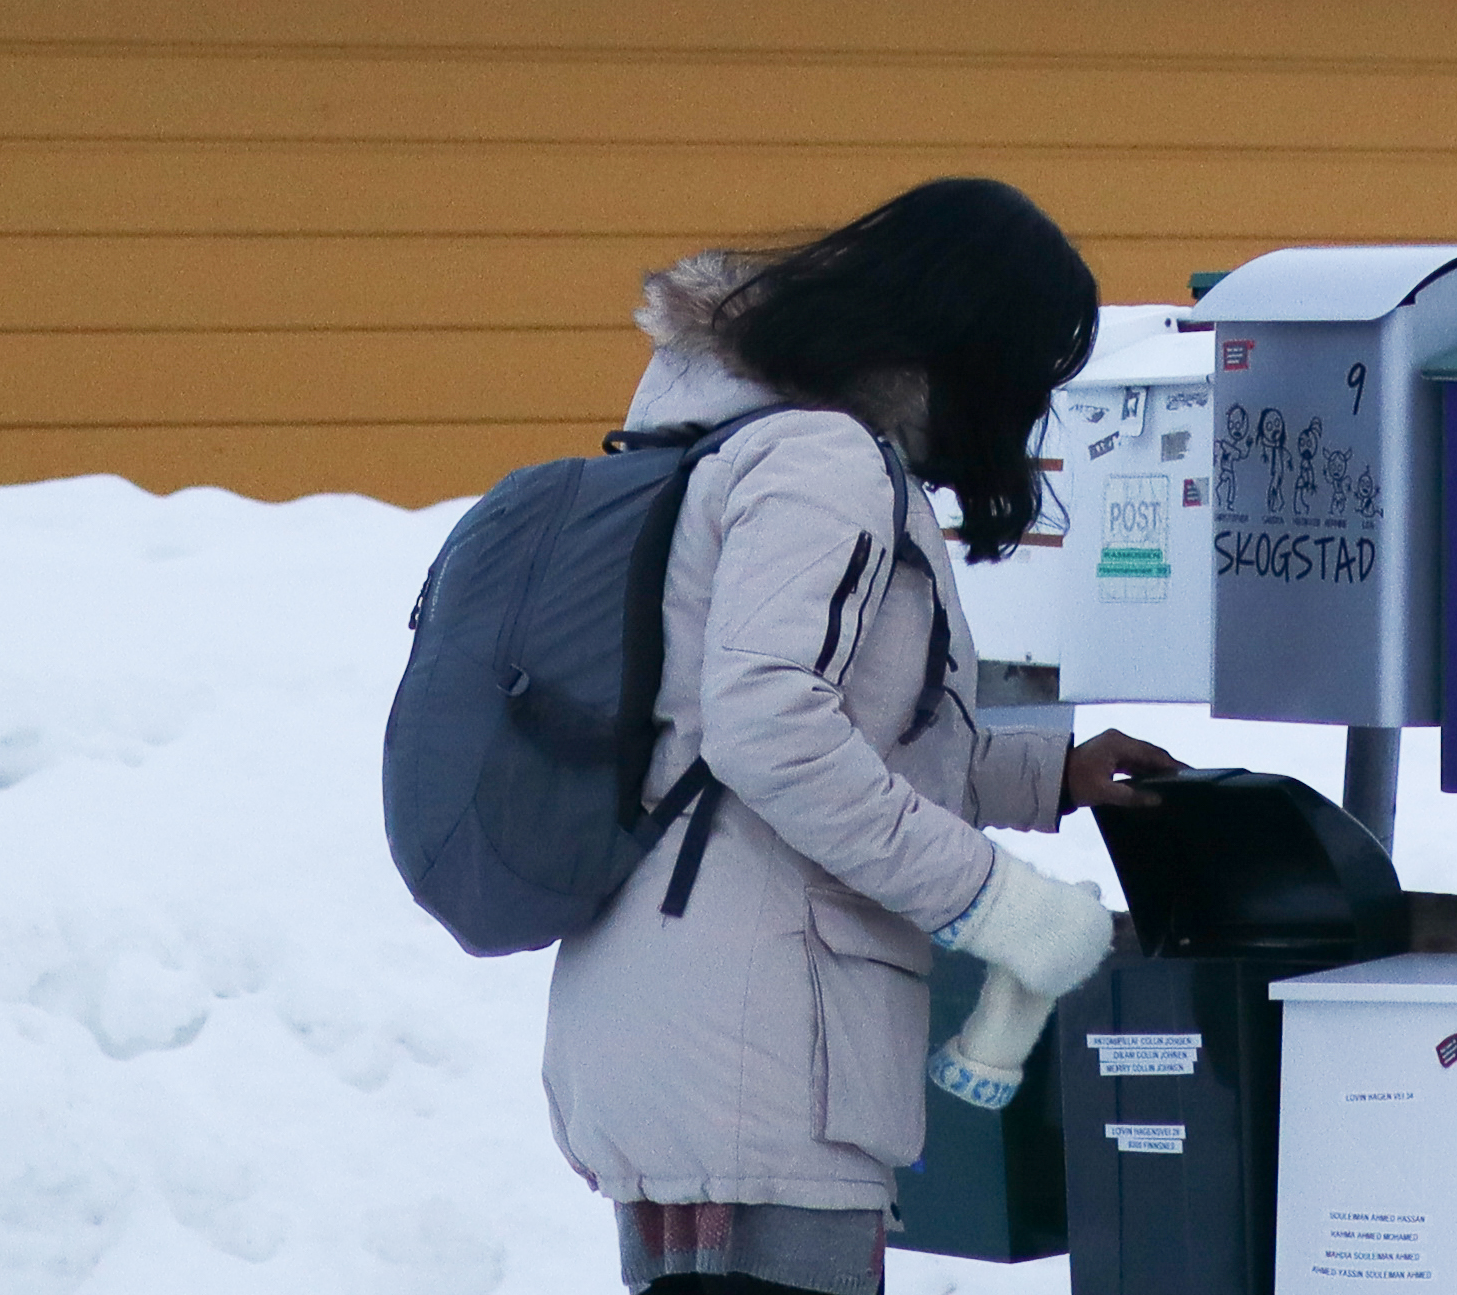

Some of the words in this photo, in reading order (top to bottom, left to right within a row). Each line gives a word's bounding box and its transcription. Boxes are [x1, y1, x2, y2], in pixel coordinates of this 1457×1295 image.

[1347, 362, 1366, 415] 9
[1109, 501, 1161, 532] POST
[1214, 530, 1376, 584] SKOGSTAD
[1345, 1094, 1366, 1102] LOVIN
[1368, 1093, 1392, 1101] HAGEN
[1371, 1213, 1395, 1222] AHMED
[1397, 1215, 1425, 1223] HASSAN
[1383, 1233, 1419, 1241] MOHAMED
[1395, 1253, 1419, 1261] AHMED
[1311, 1266, 1337, 1276] AHMED
[1339, 1269, 1363, 1277] YASSIN
[1407, 1271, 1431, 1279] AHMED
